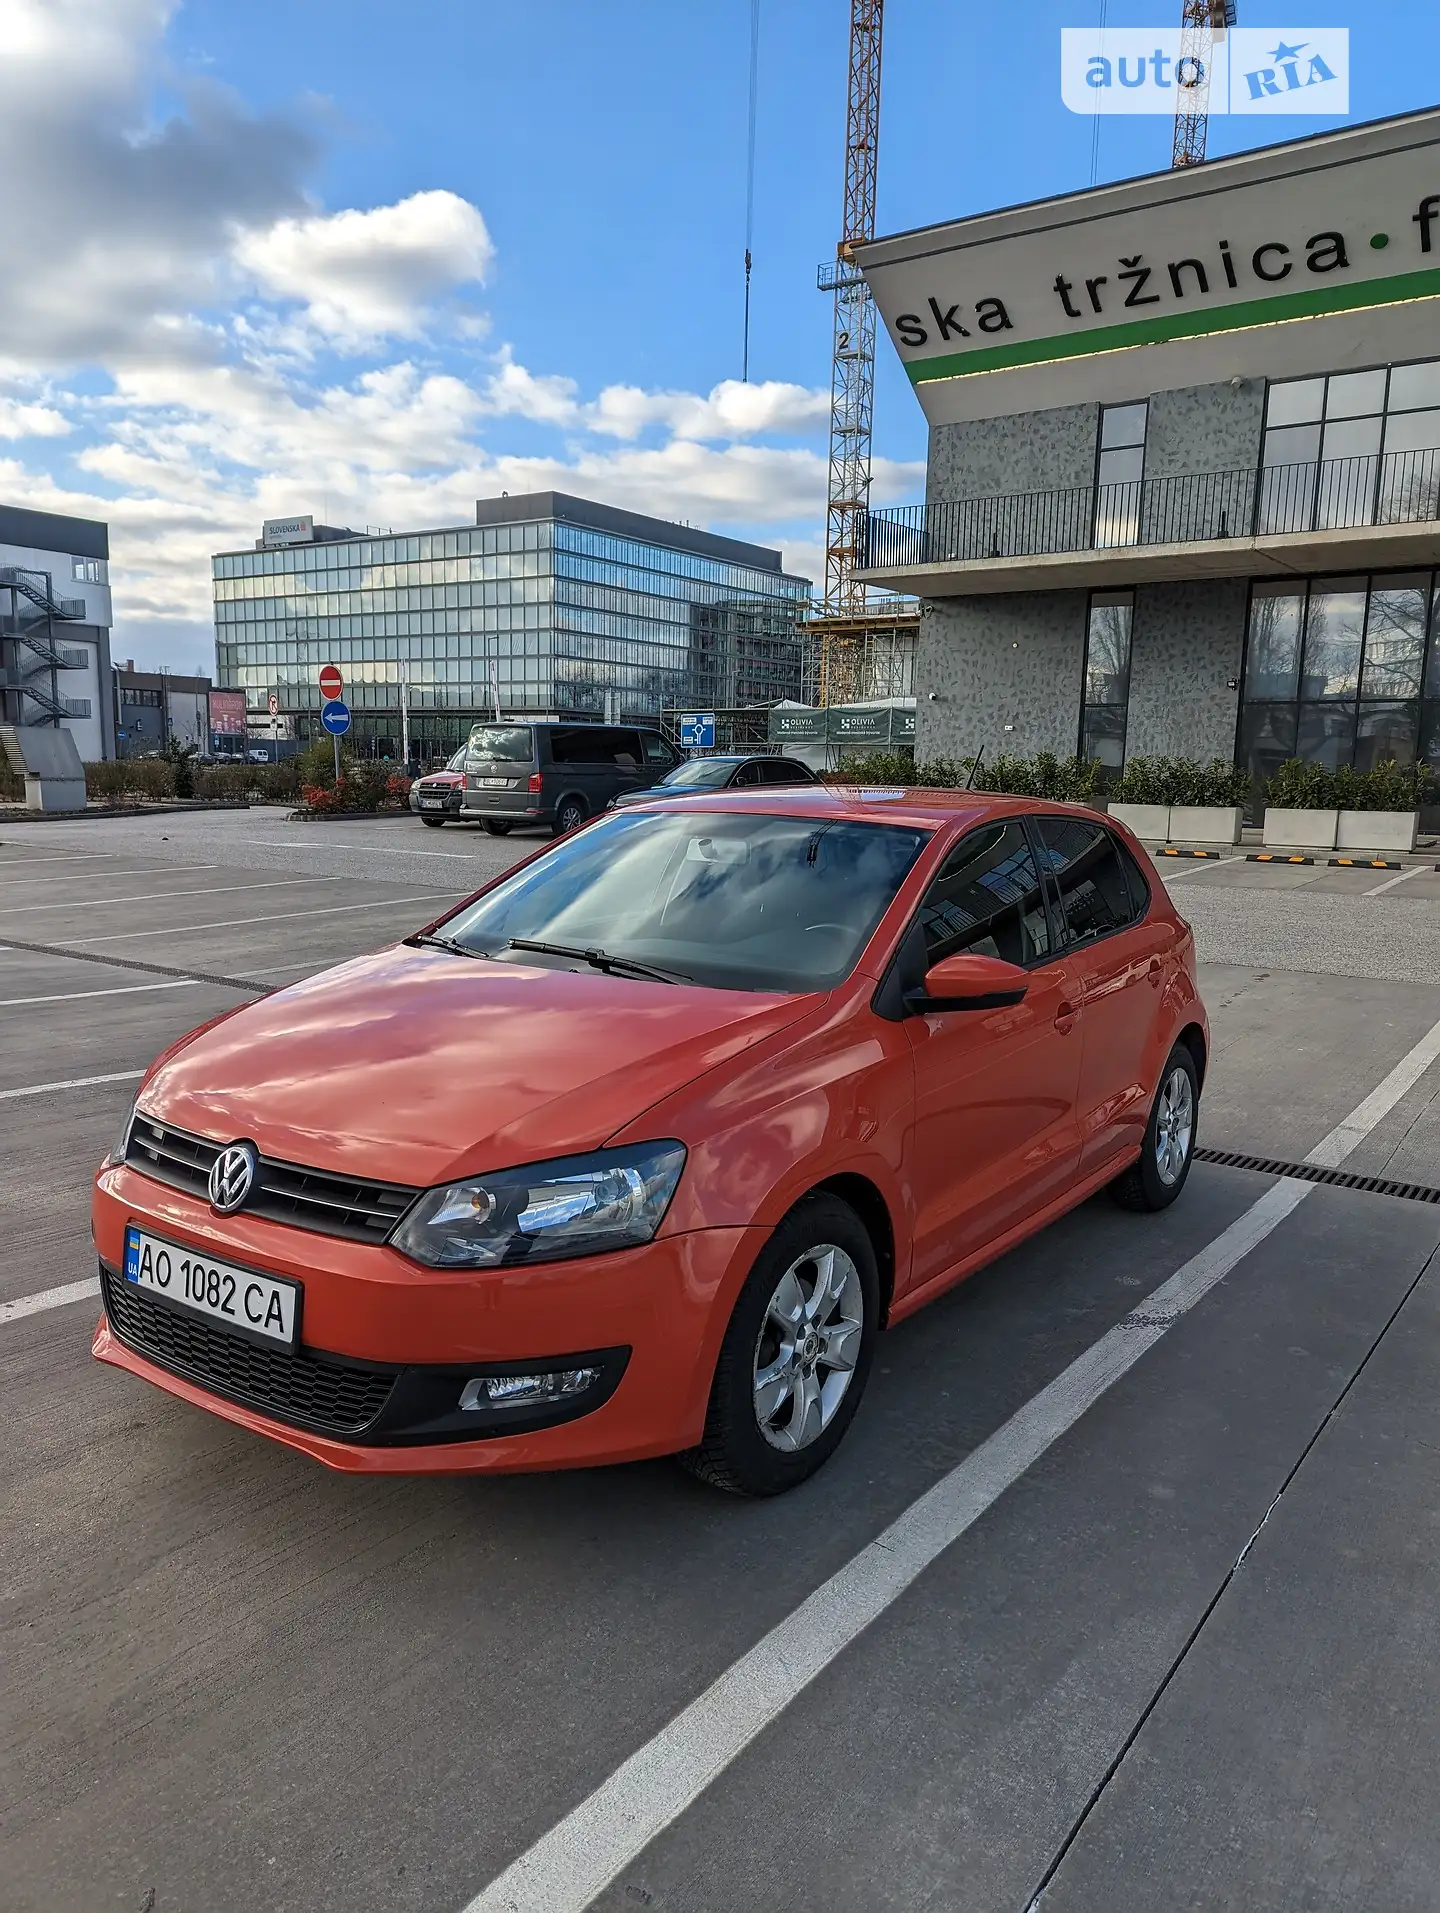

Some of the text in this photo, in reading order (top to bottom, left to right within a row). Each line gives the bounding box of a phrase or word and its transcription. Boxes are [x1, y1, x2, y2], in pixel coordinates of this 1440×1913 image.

[895, 296, 1014, 348] ska
[1053, 230, 1350, 319] tržnica
[839, 332, 849, 350] 2
[269, 524, 301, 535] SLOVENSKA
[790, 718, 813, 726] OLIVIA
[851, 718, 875, 726] OLIVIA
[127, 1261, 138, 1276] UA
[139, 1243, 285, 1334] AO 1082 CA
